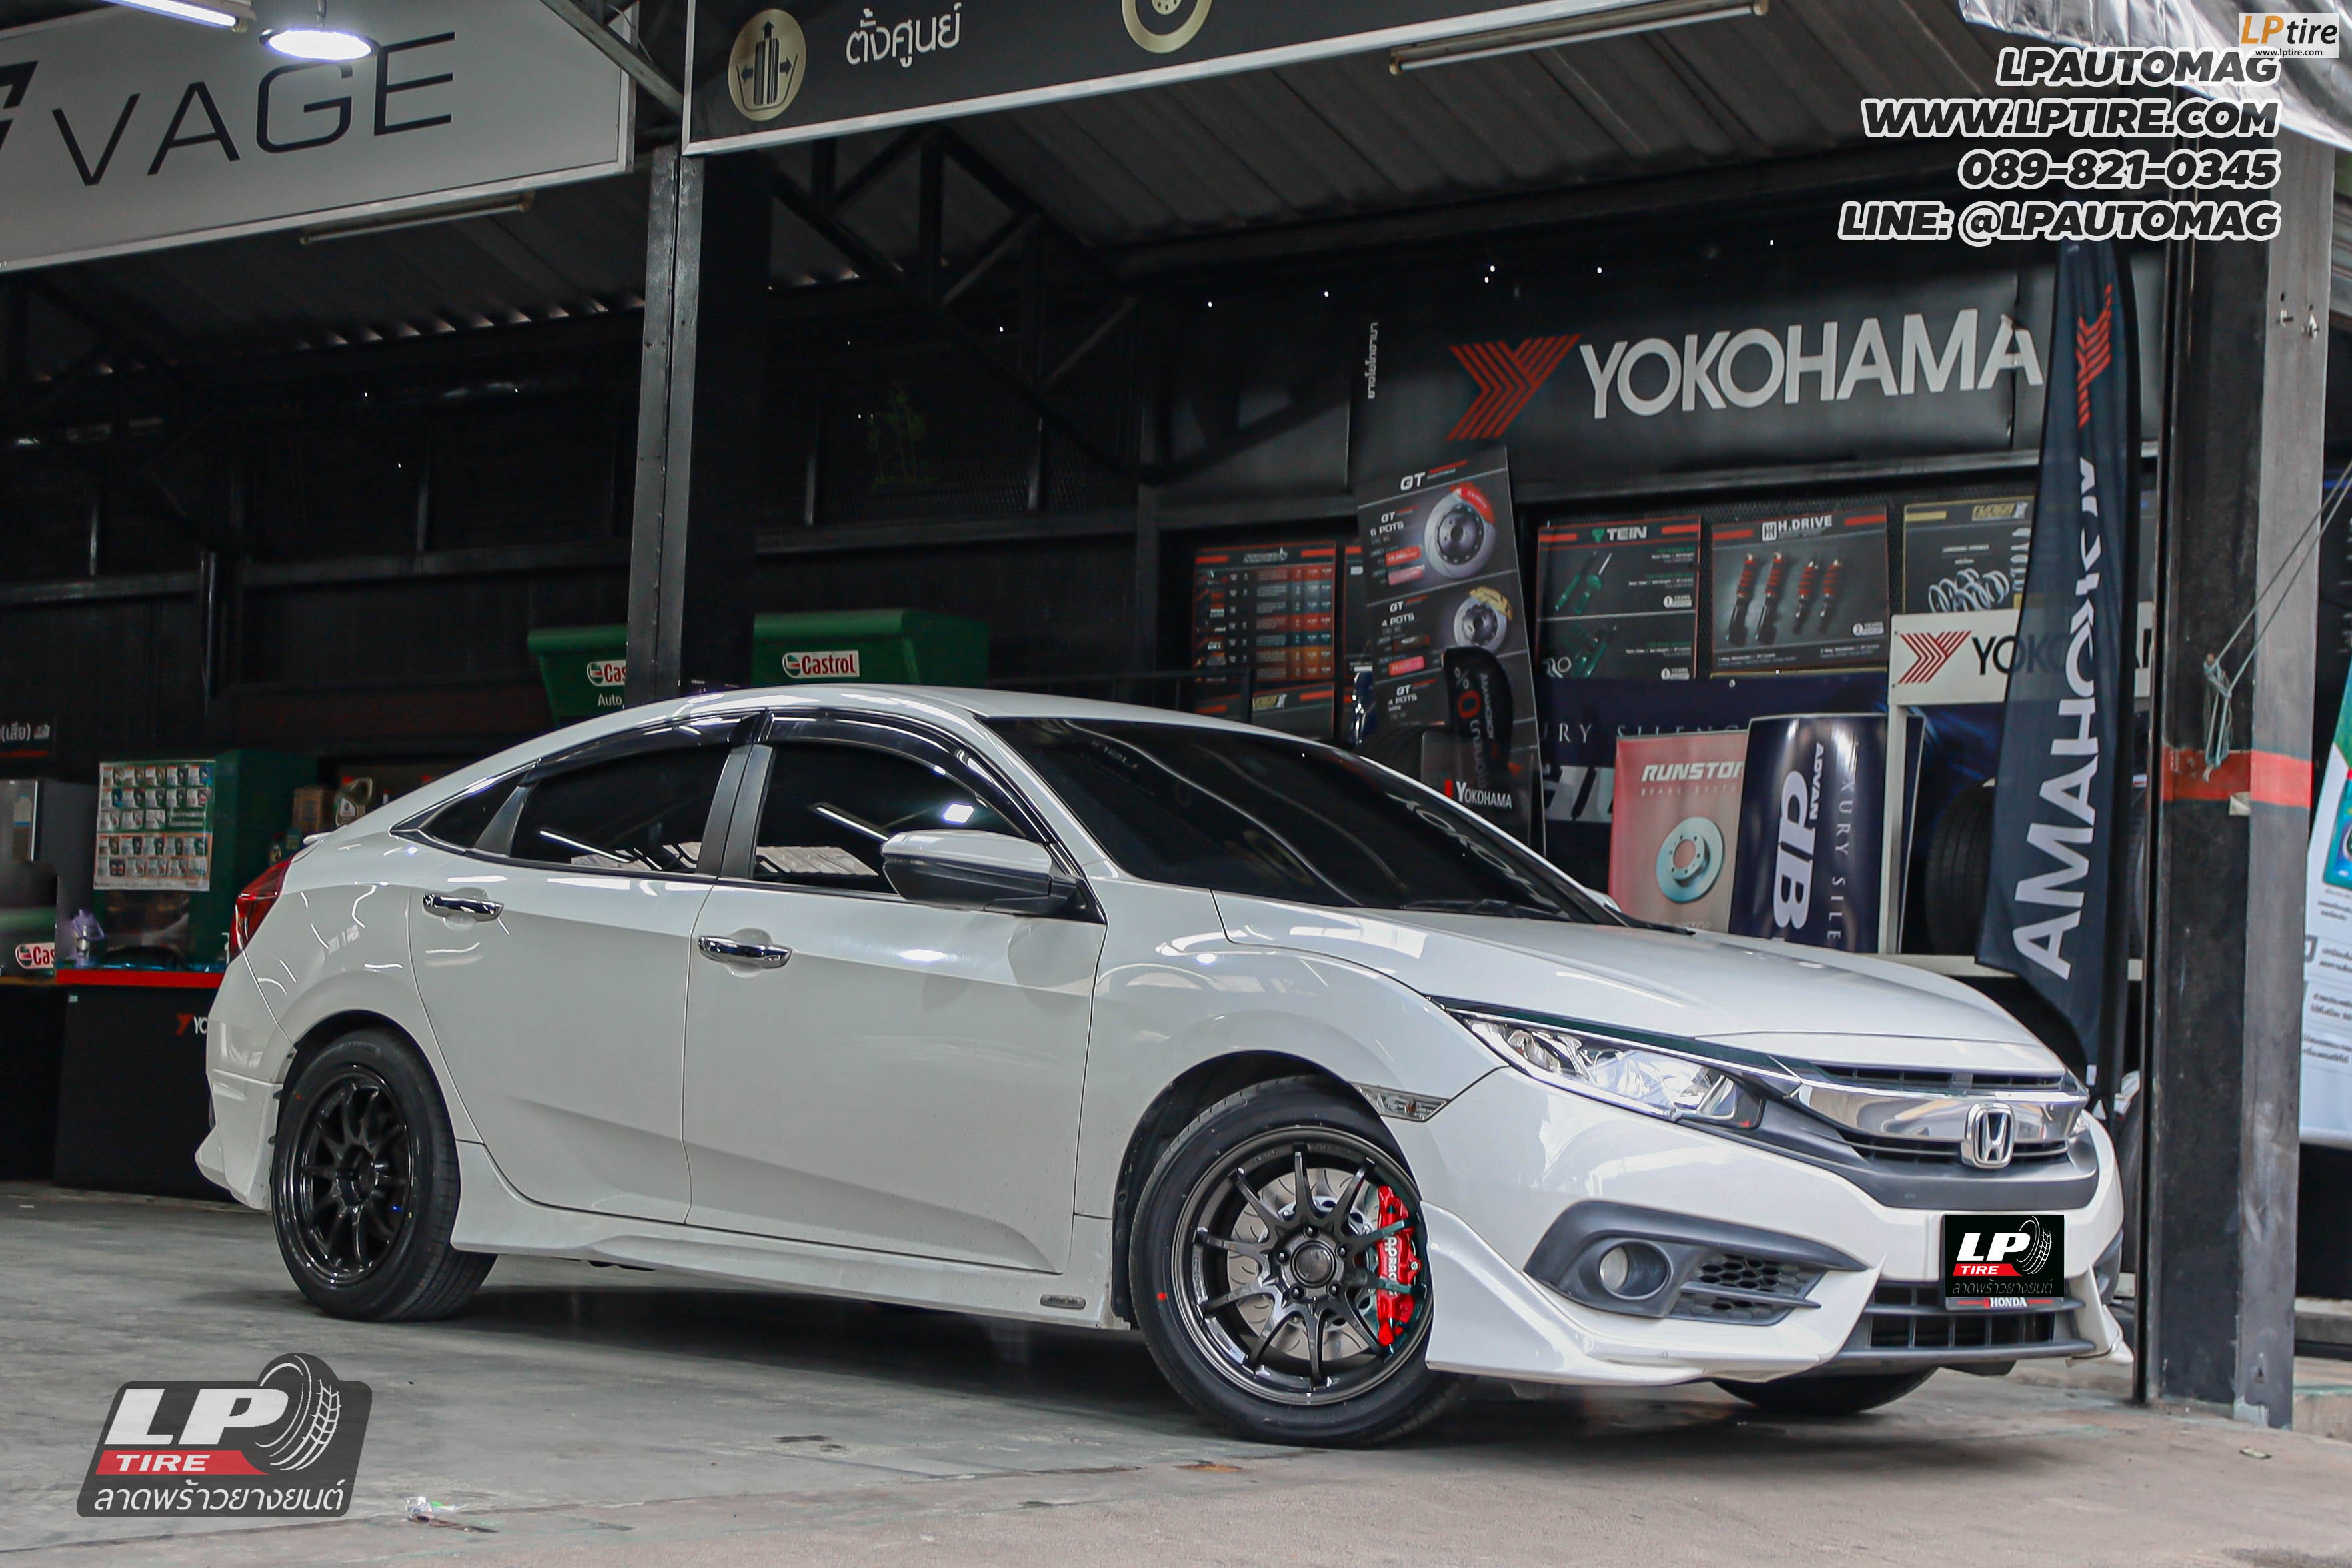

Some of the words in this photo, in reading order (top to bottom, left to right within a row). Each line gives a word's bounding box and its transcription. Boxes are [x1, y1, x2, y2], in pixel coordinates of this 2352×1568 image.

[846, 2, 961, 68] ตั้งศูนย์
[1579, 308, 2044, 420] YOKOHAMA
[1400, 472, 1426, 492] GT
[1606, 526, 1648, 541] TEIN
[801, 653, 855, 676] Castrol
[598, 693, 623, 707] Auto
[1809, 742, 1825, 820] ADVAN
[1455, 780, 1512, 810] YOKOHAMA
[1989, 1297, 2028, 1308] HONDA
